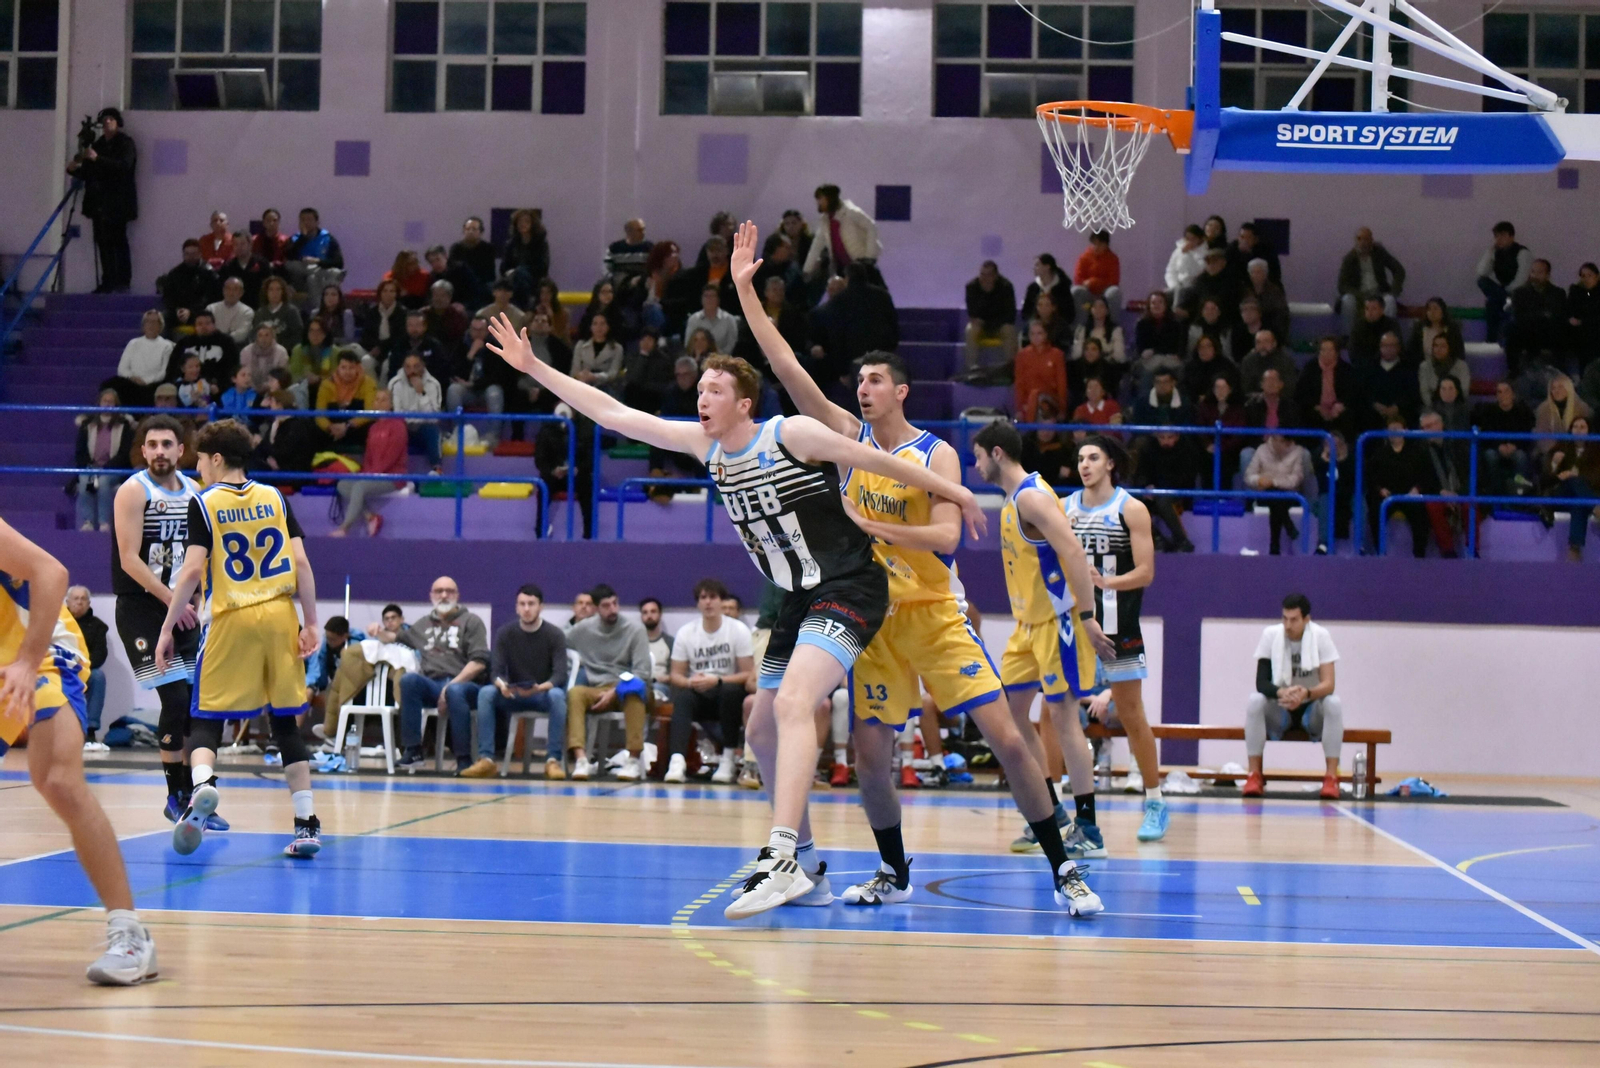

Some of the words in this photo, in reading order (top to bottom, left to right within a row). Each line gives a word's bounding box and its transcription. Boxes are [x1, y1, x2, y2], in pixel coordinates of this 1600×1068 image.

[1277, 124, 1357, 143] SPORT
[1359, 126, 1459, 146] SYSTEM
[217, 503, 275, 524] GUILLÉN
[160, 520, 189, 541] UL
[221, 526, 292, 583] 82
[823, 618, 847, 639] 17
[863, 684, 889, 702] 13
